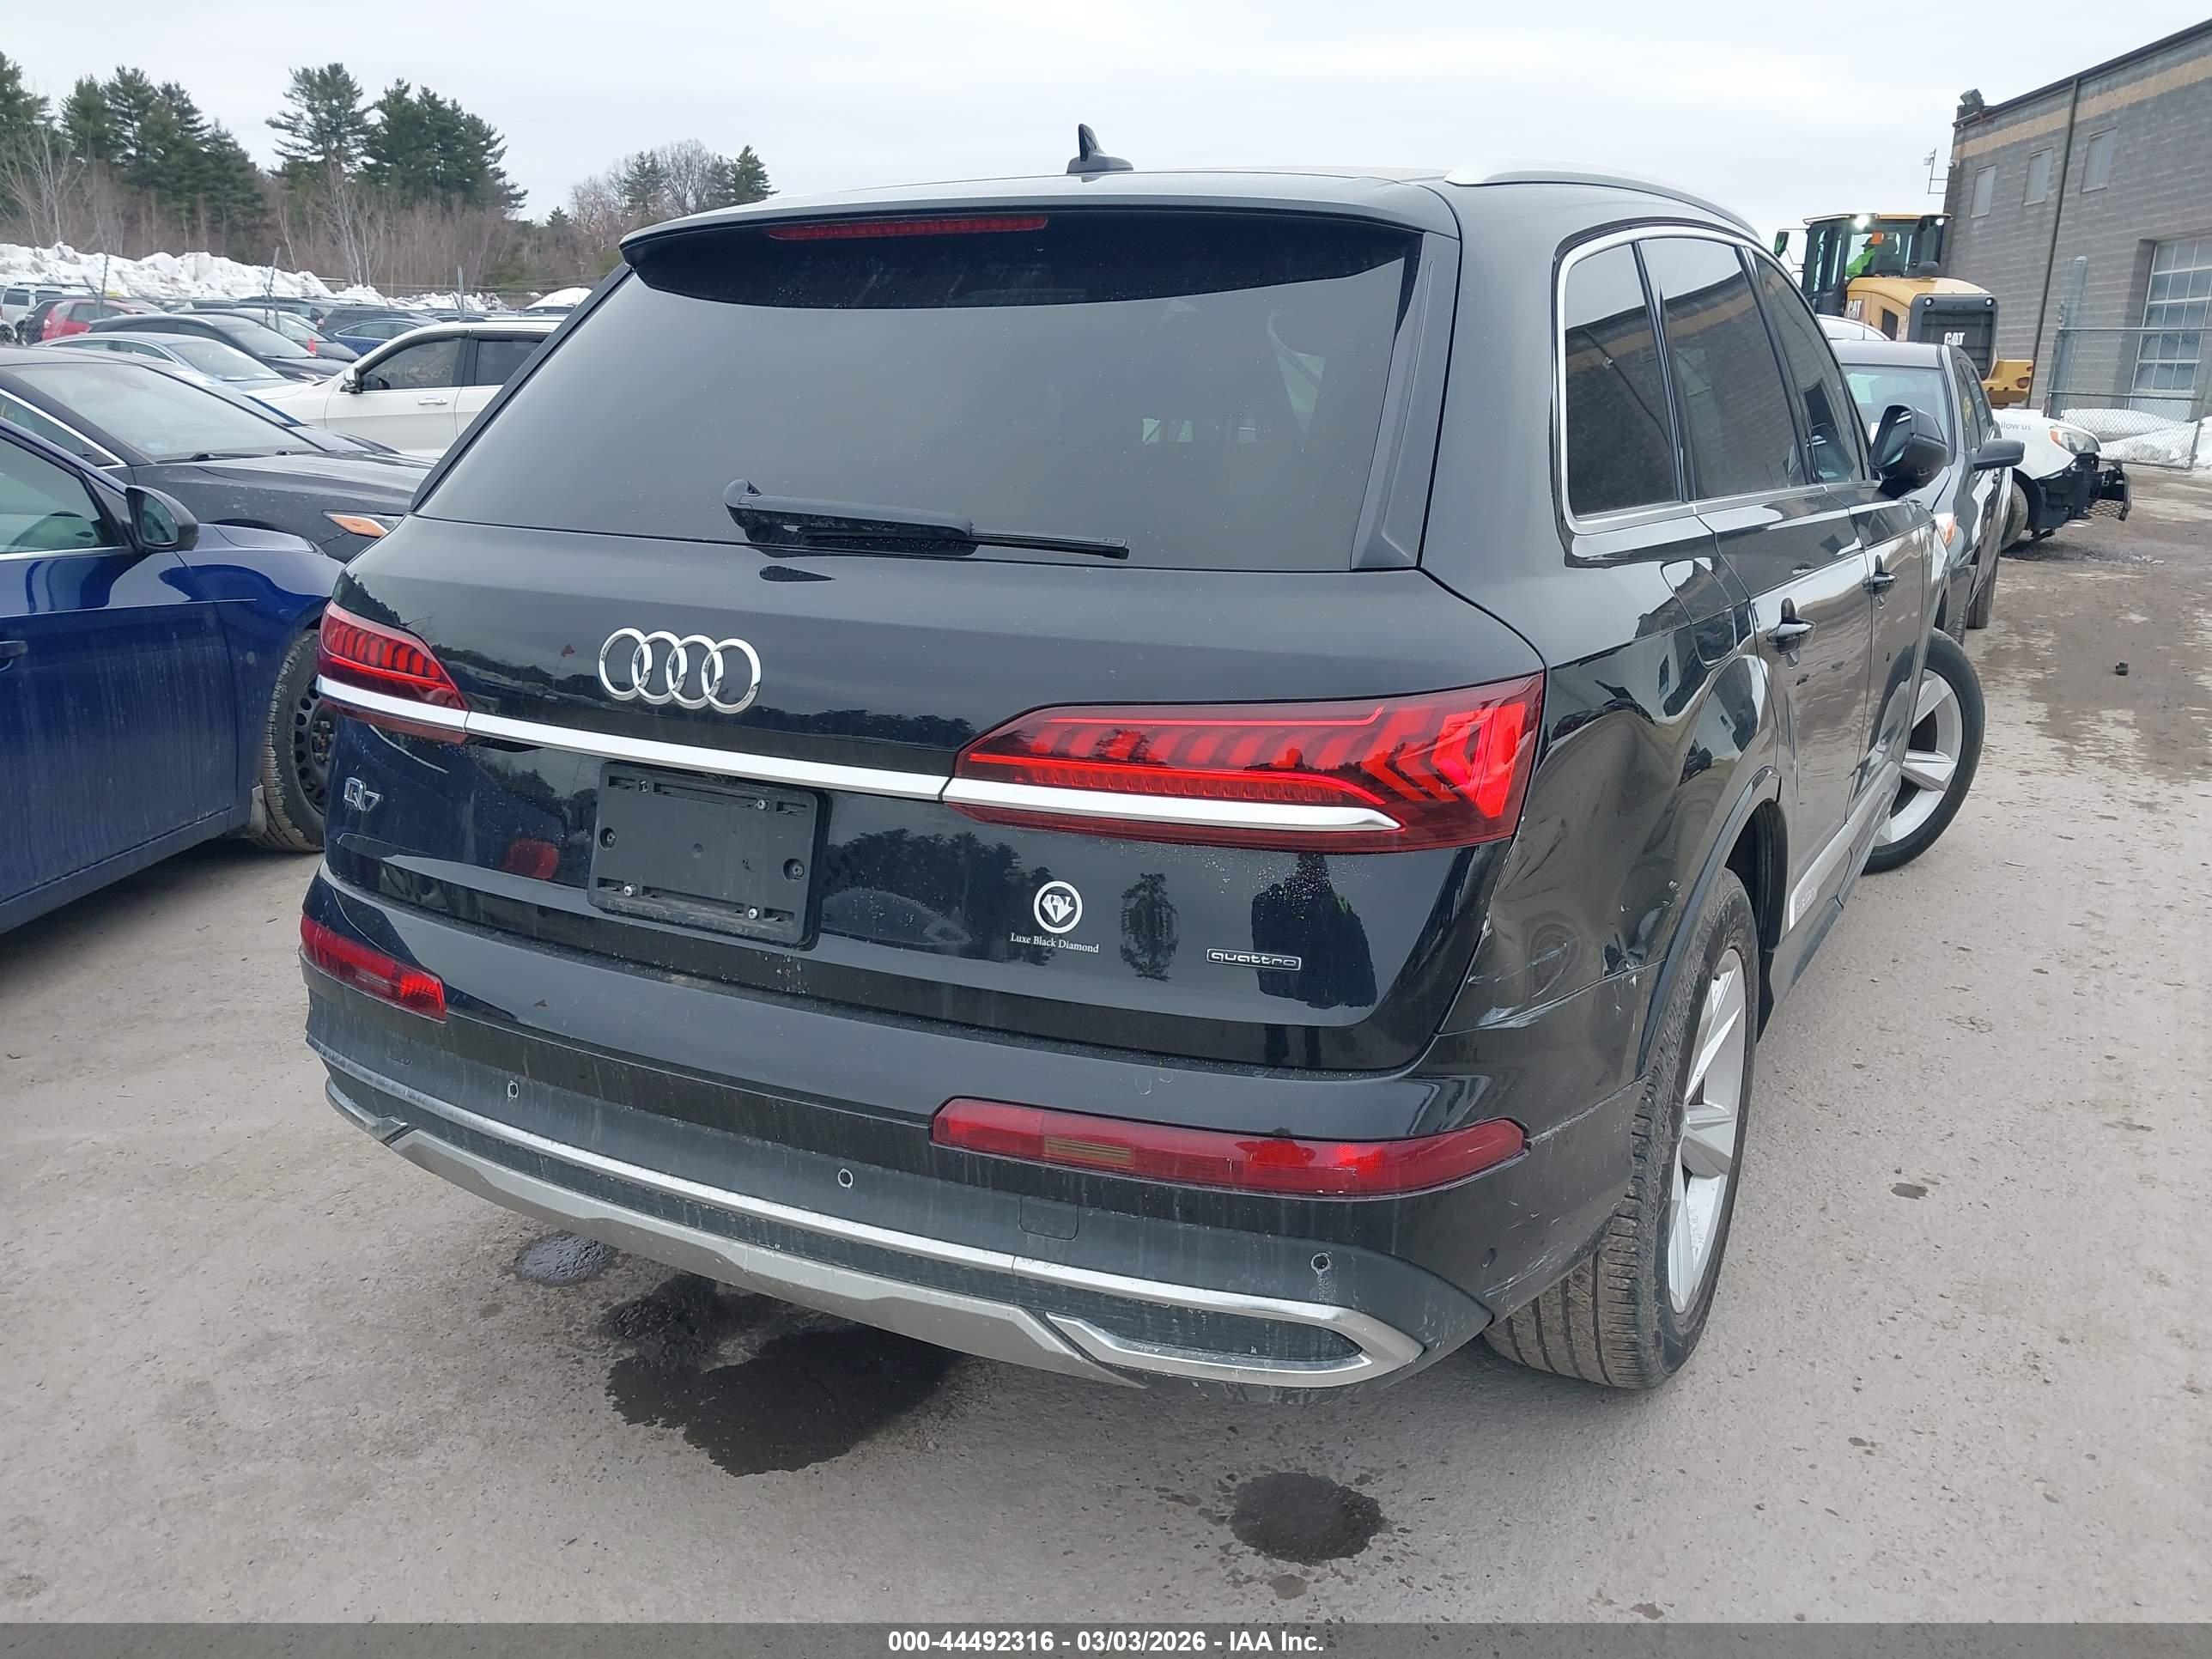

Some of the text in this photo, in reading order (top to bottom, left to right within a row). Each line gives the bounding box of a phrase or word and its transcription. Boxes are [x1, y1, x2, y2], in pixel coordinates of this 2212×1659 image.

[1847, 300, 1862, 319] CAT
[1944, 331, 1966, 345] CAT
[2001, 420, 2020, 429] llow
[343, 777, 383, 811] Q7
[1010, 933, 1099, 953] Luxe Black Diamond
[1211, 951, 1297, 966] quattro
